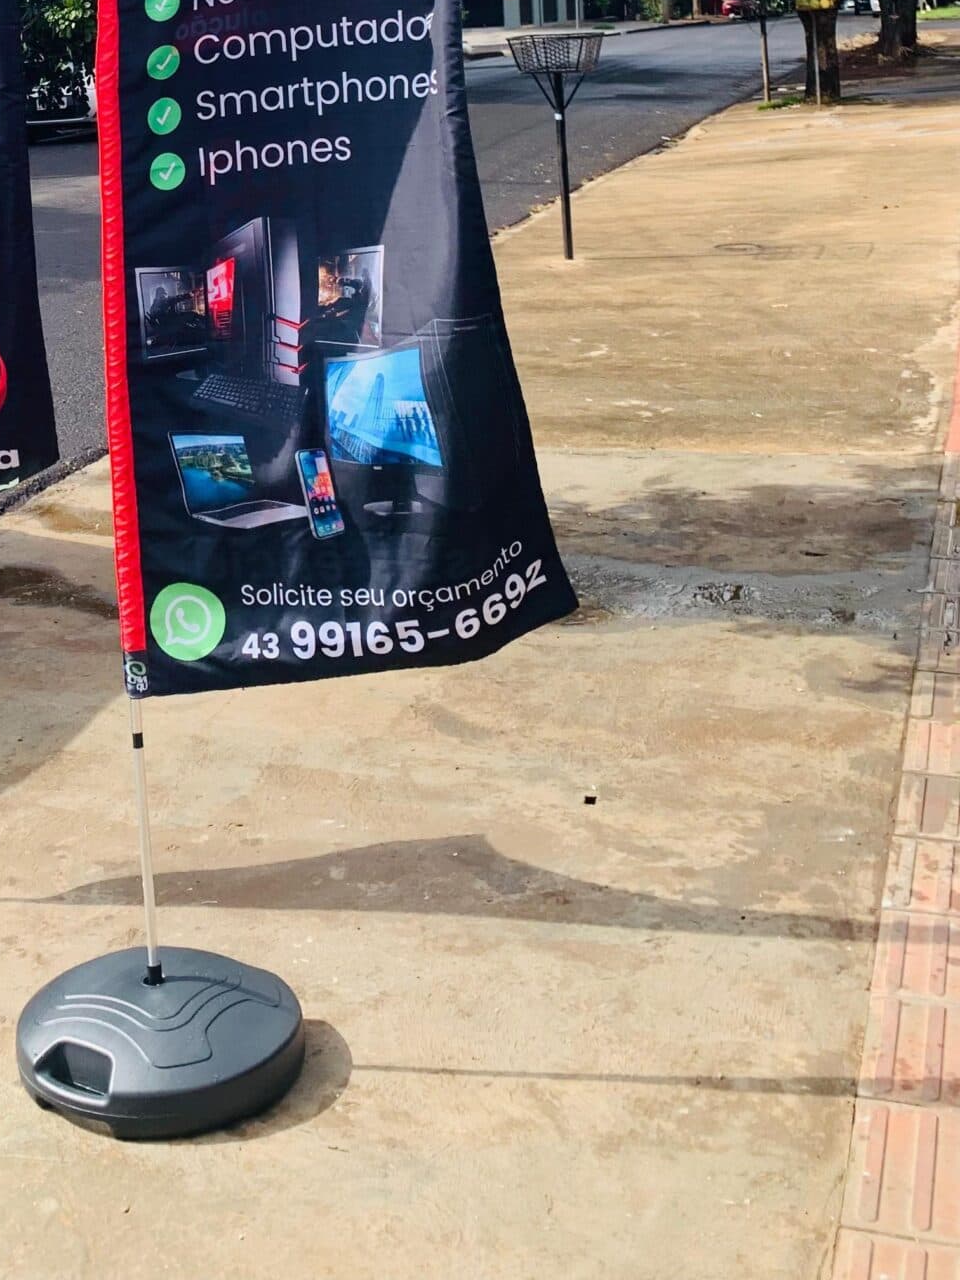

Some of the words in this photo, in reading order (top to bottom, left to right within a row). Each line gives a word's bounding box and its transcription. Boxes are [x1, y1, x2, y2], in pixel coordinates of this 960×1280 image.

[198, 135, 352, 186] Iphones
[240, 581, 333, 607] Solicite
[339, 584, 385, 607] seu
[391, 538, 523, 612] orçamento
[241, 631, 281, 660] 43
[289, 558, 548, 661] 99165-6692
